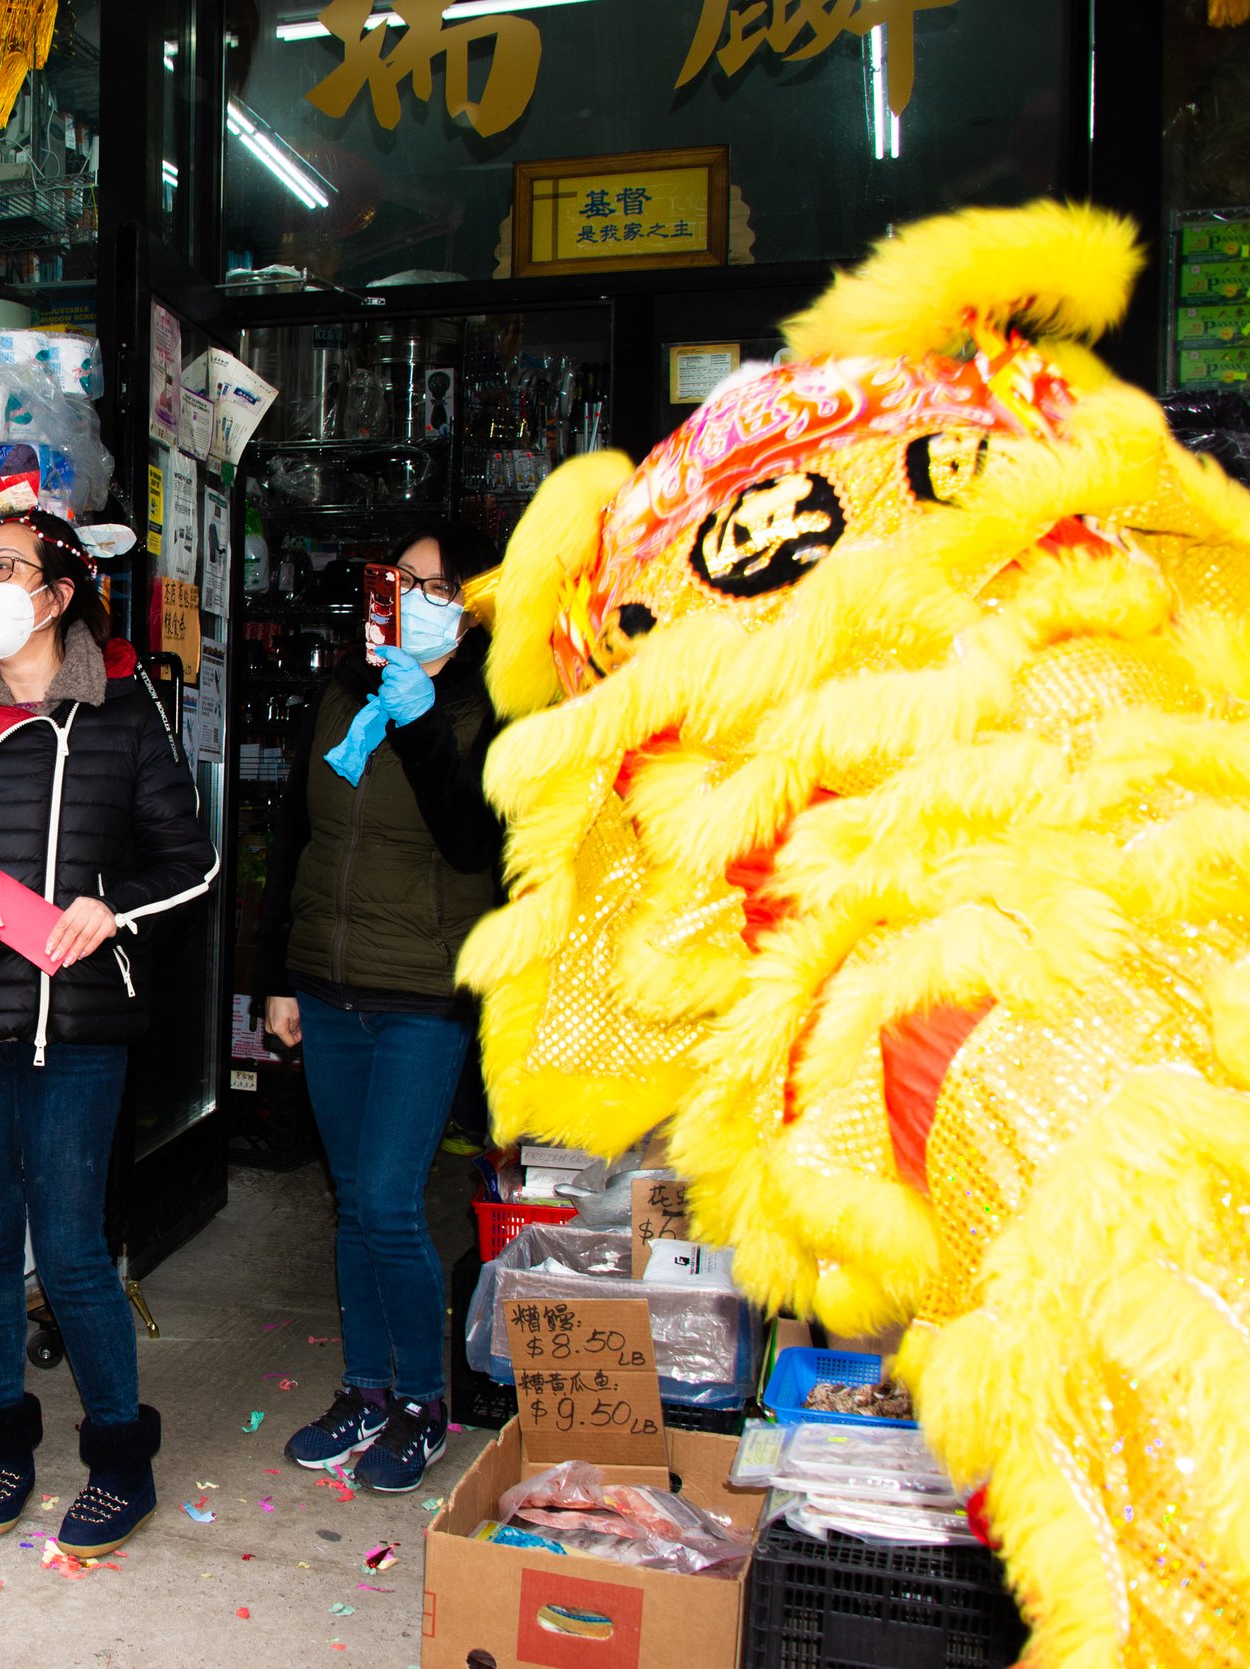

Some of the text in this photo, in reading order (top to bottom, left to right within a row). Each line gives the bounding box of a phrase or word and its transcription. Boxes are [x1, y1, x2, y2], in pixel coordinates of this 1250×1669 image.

[579, 187, 652, 219] 基督
[576, 220, 693, 244] 是我家之主
[155, 701, 170, 732] MONCLER
[618, 1351, 646, 1366] LB
[630, 1418, 658, 1435] LB
